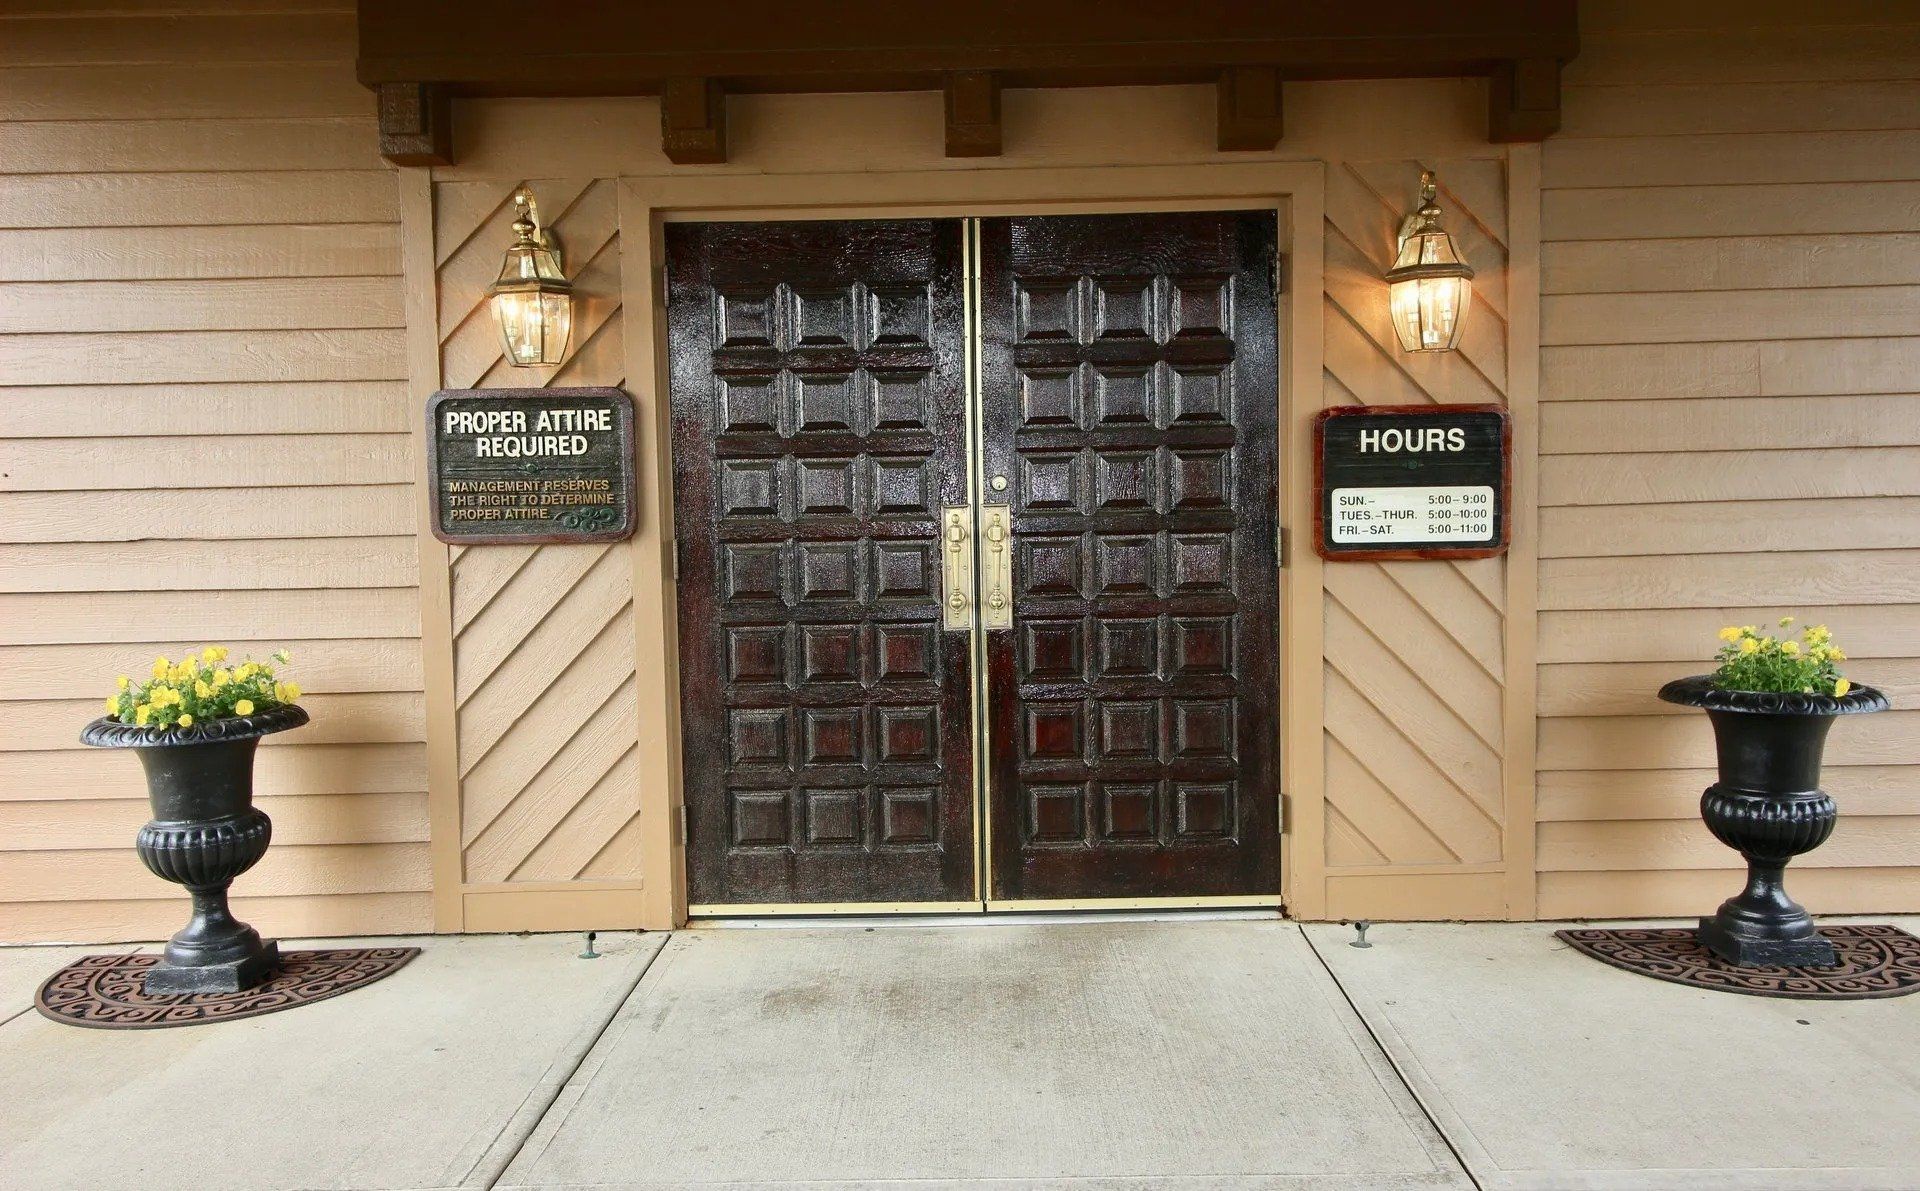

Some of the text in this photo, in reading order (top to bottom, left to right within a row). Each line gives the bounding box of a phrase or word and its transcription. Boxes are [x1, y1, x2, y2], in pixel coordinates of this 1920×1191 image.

[446, 408, 612, 434] PROPER ATTIRE
[476, 434, 589, 458] REQUIRED
[1359, 427, 1466, 453] HOURS
[449, 479, 610, 493] MANAGEMENT RESERVES
[450, 493, 615, 506] THE RIGHT TO DETERMINE
[450, 508, 501, 520] PROPER
